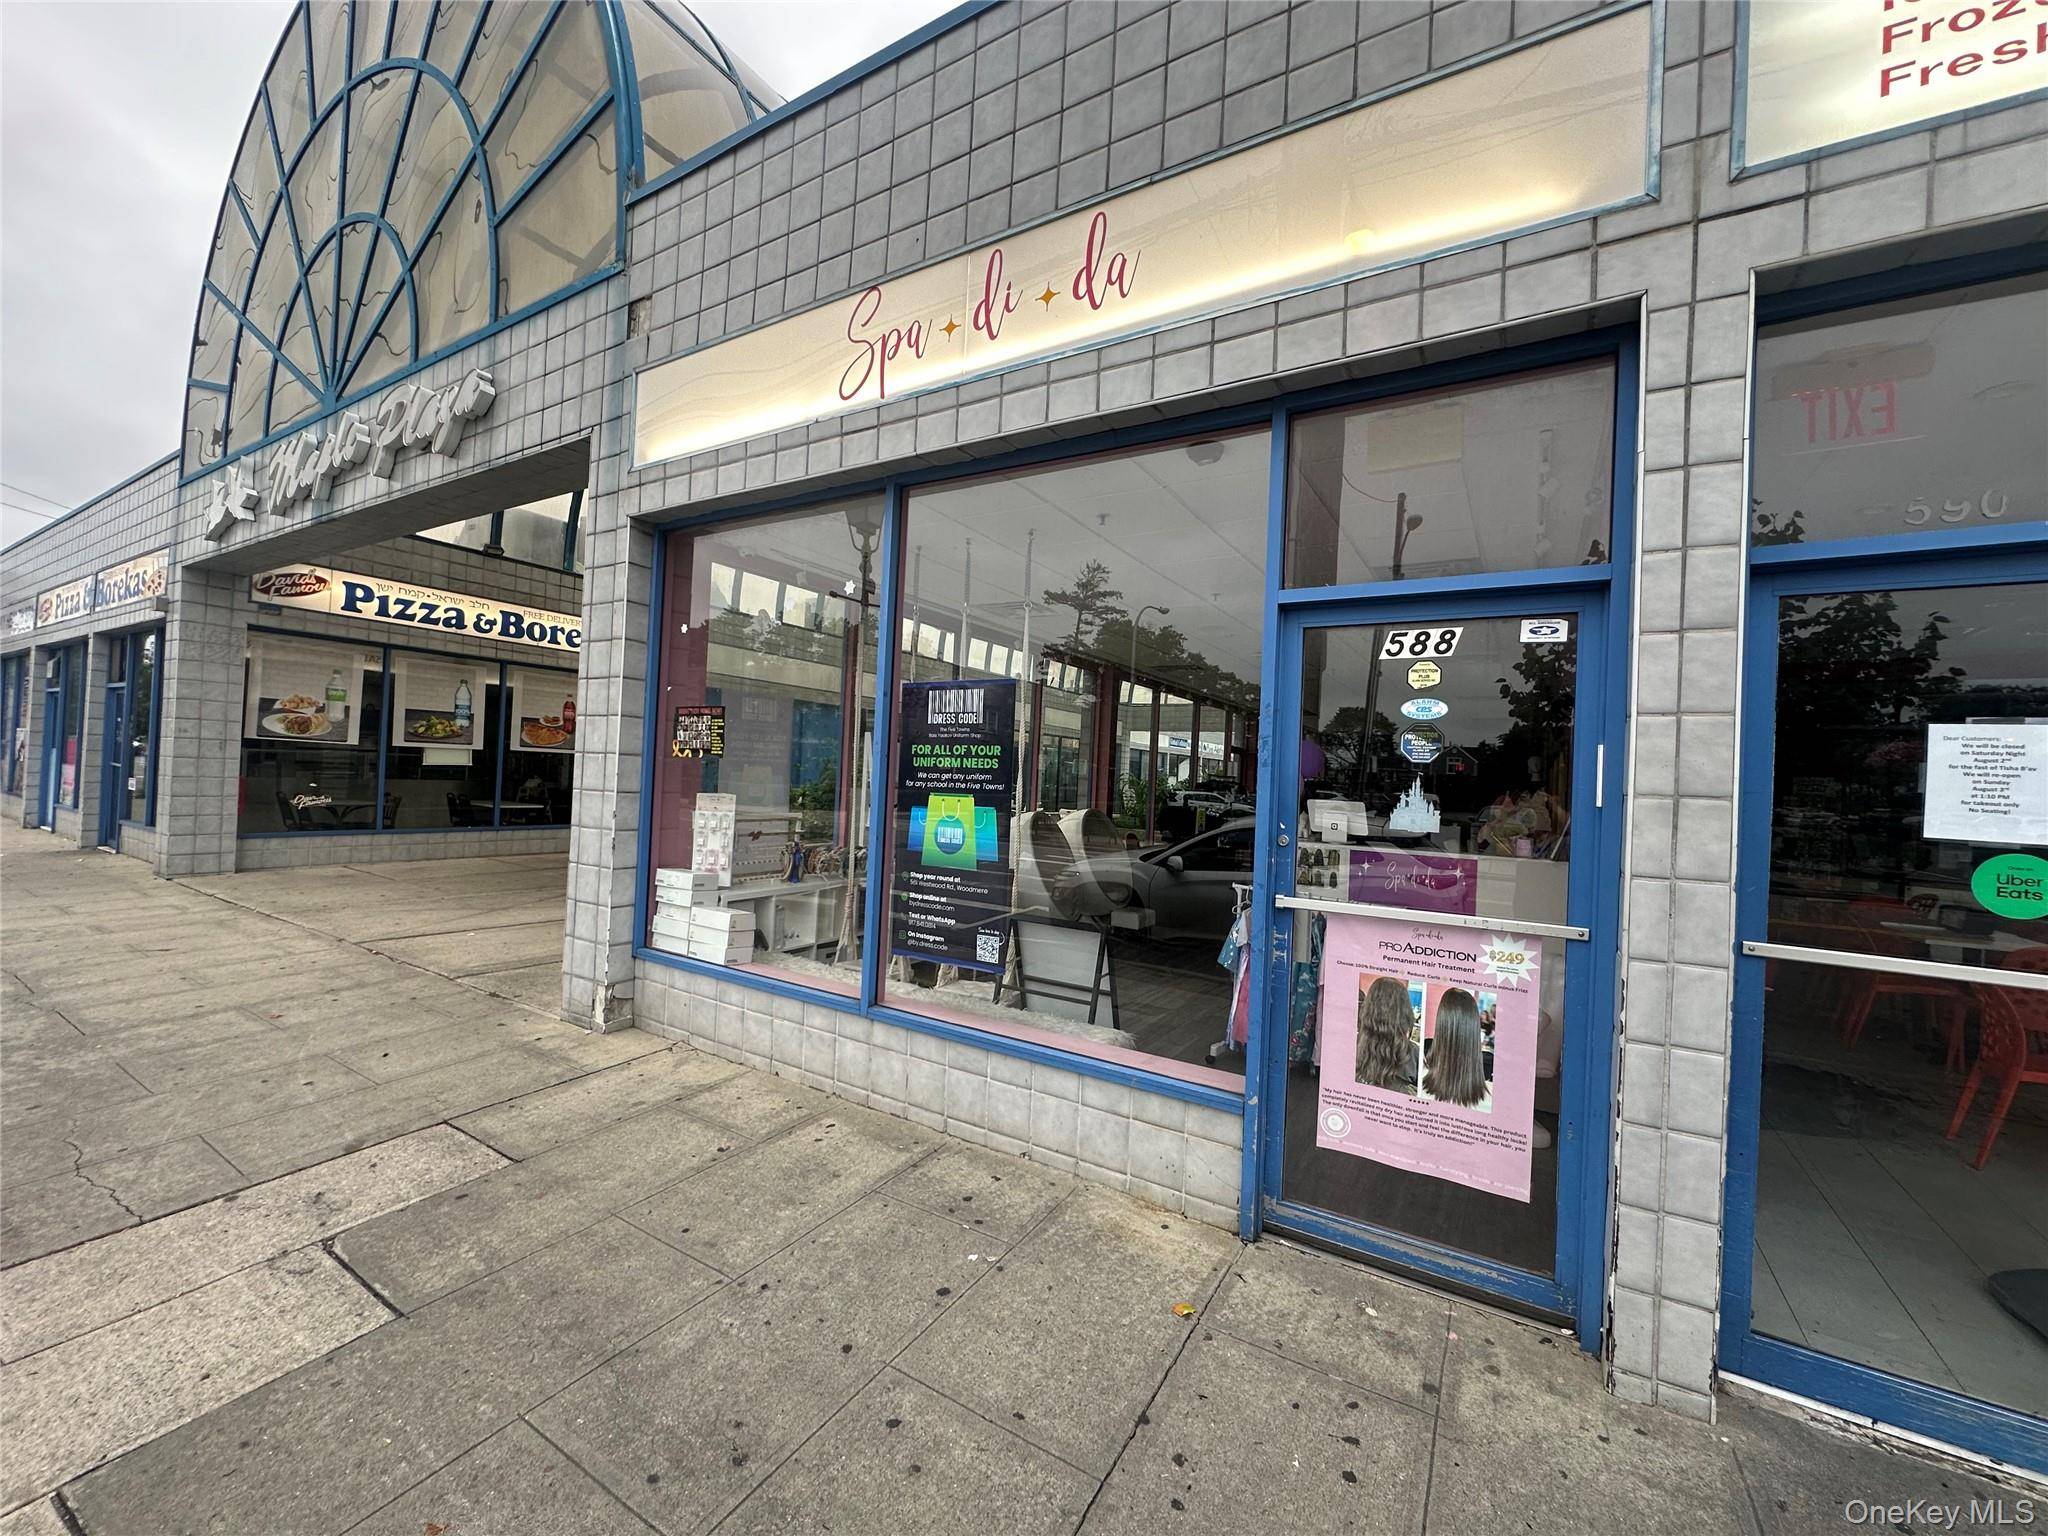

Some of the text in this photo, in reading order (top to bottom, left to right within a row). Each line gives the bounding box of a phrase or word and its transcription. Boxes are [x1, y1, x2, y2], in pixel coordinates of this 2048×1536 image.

[1882, 0, 2048, 54] Froz
[838, 211, 1142, 401] Spa di da
[1903, 487, 2009, 526] 590
[54, 591, 81, 620] Pizza
[95, 567, 149, 608] Borekas
[340, 580, 468, 630] Pizza
[473, 613, 497, 634] &
[523, 610, 545, 621] FREE
[1385, 629, 1457, 657] 588
[933, 713, 978, 724] DRESS CODE
[911, 744, 1001, 756] FOR ALL OF YOUR
[913, 757, 999, 769] UNIFORM NEEDS
[941, 772, 952, 780] get
[952, 773, 965, 781] any
[927, 780, 948, 788] school
[910, 871, 923, 880] Shop
[1996, 873, 2044, 887] Uber
[956, 885, 988, 894] Woodmere
[1995, 886, 2044, 901] Eats
[909, 892, 923, 900] Shop
[923, 894, 939, 902] online
[927, 915, 956, 926] WhatsApp
[916, 932, 945, 942] Instagram
[1369, 965, 1388, 973] Straight
[1382, 954, 1476, 974] Permanent Hair Treatment
[1463, 979, 1483, 987] Natural
[1322, 1094, 1348, 1103] completely
[1474, 1129, 1486, 1137] long
[1488, 1132, 1509, 1142] healthy
[1344, 1104, 1364, 1113] downfall
[1451, 1130, 1479, 1141] difference
[1405, 1107, 1428, 1116] stronger
[1503, 1129, 1527, 1139] product
[1423, 1130, 1436, 1138] truly
